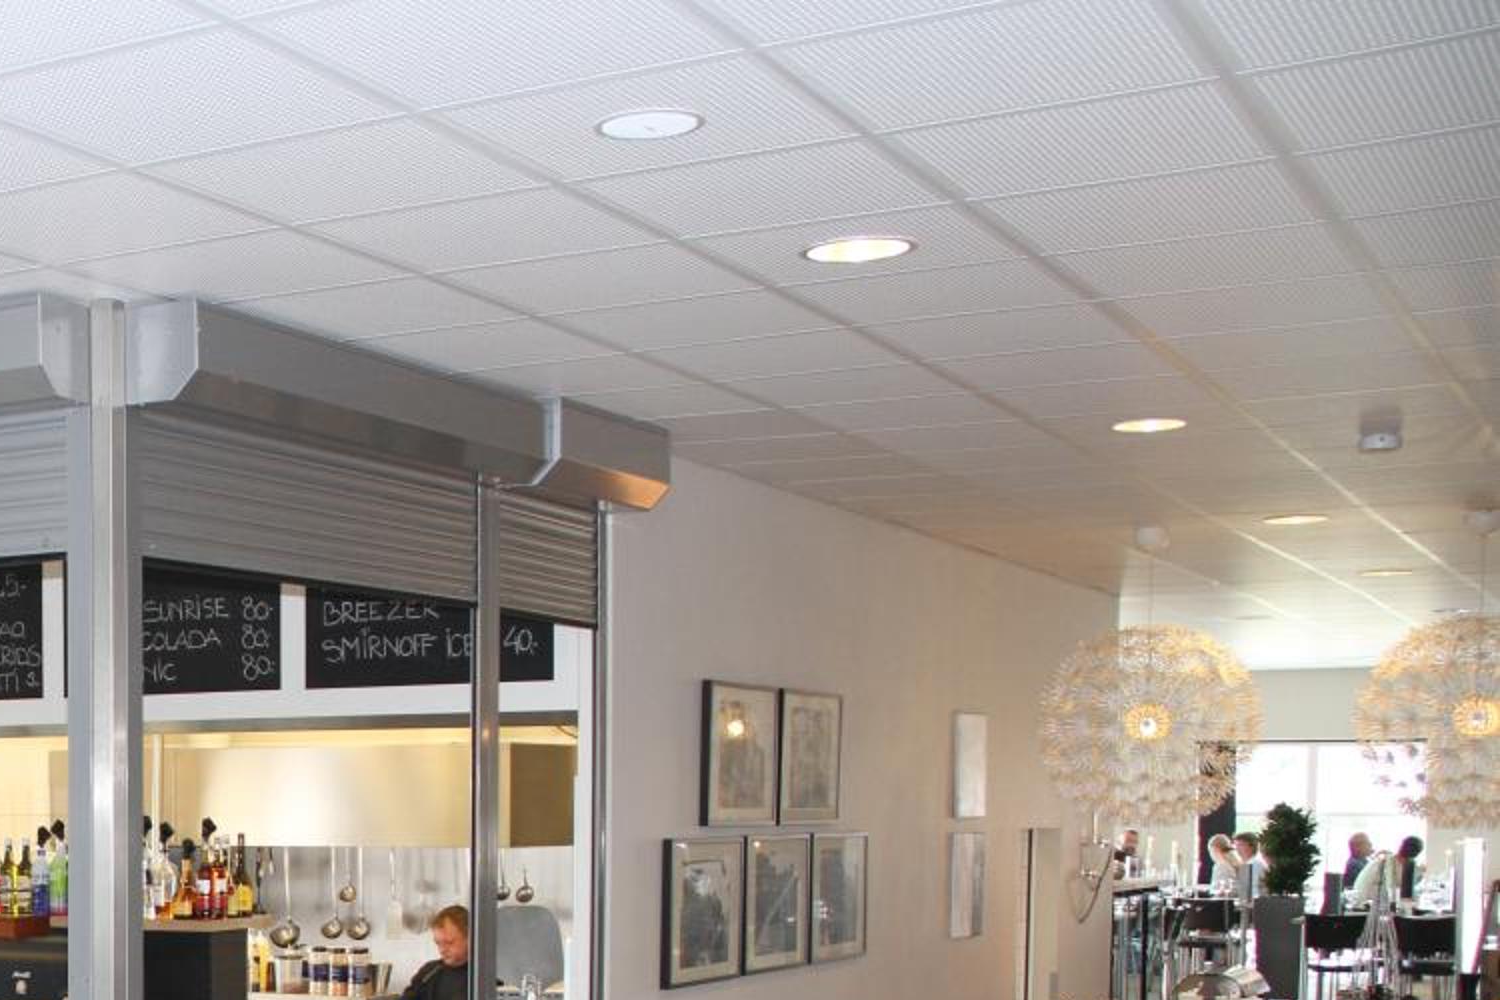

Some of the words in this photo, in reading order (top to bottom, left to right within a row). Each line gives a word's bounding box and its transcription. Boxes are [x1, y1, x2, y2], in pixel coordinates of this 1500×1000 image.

[143, 594, 230, 623] SUNRISE
[322, 600, 441, 627] BREEZER
[142, 627, 222, 651] COLADA
